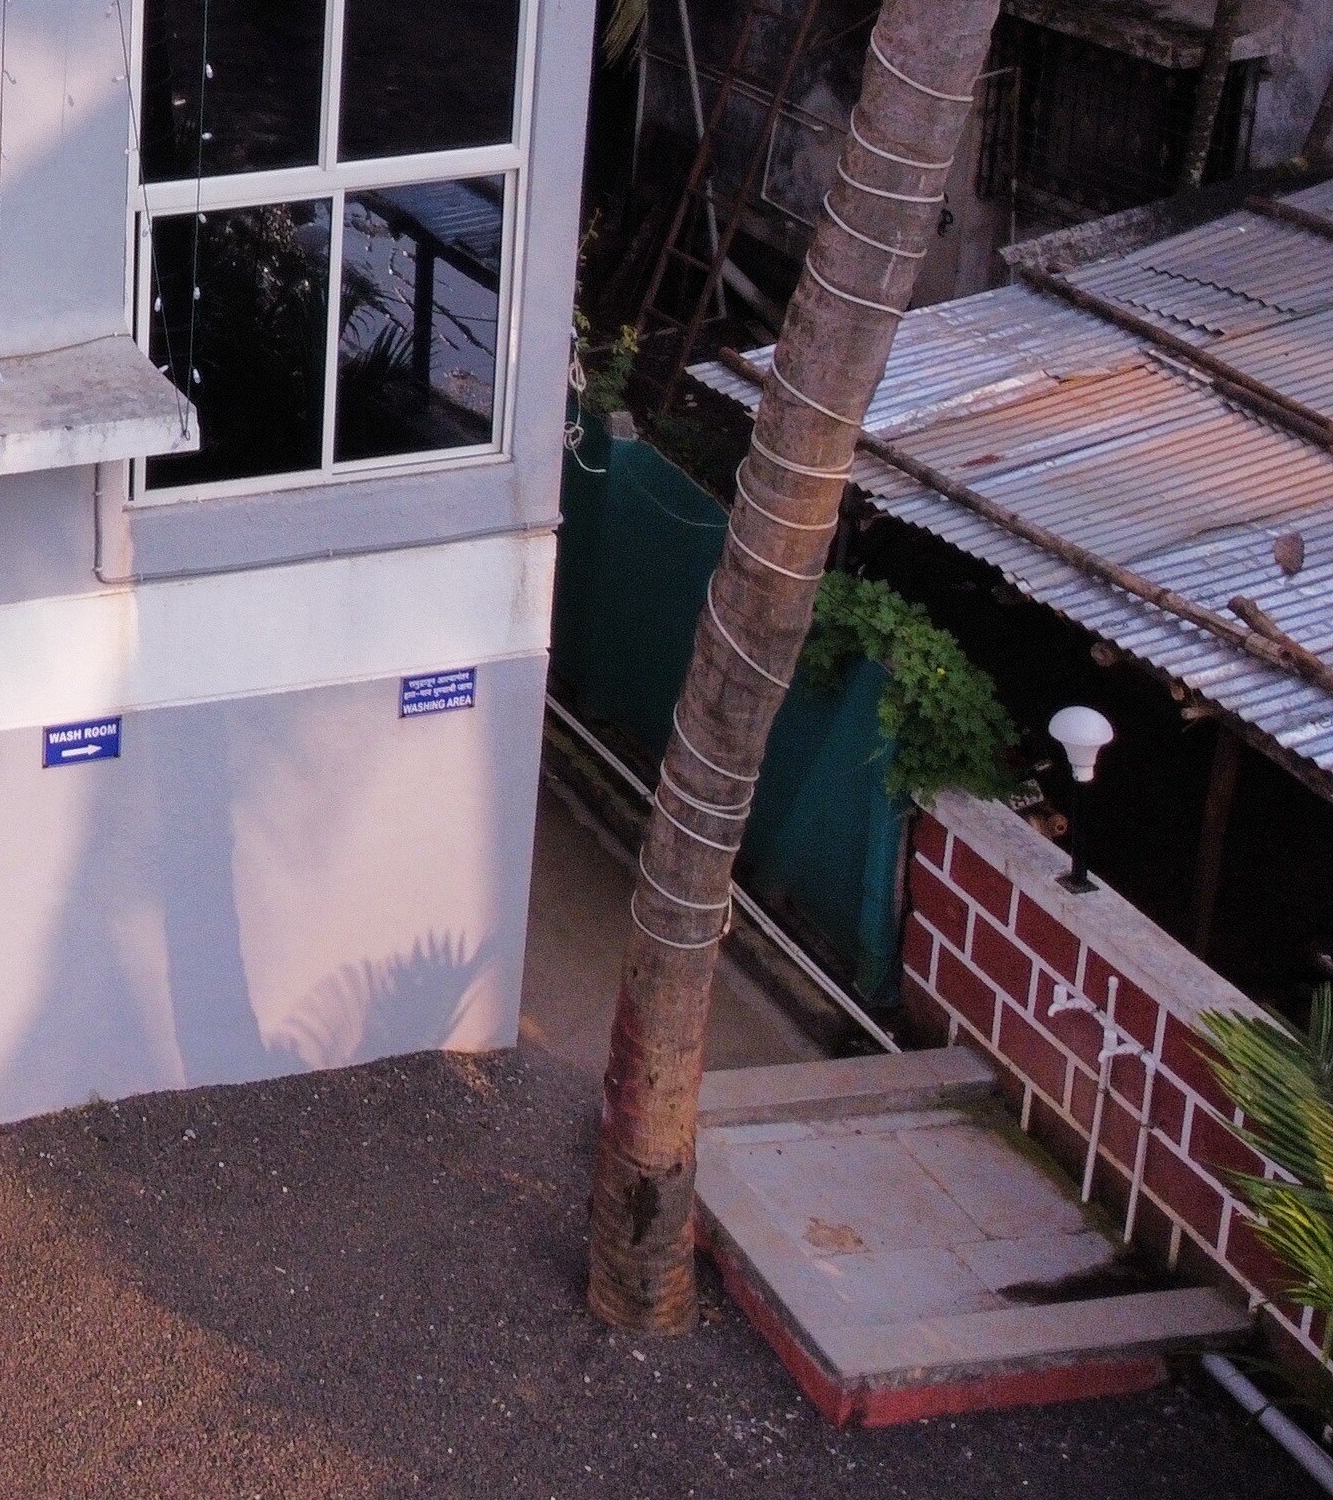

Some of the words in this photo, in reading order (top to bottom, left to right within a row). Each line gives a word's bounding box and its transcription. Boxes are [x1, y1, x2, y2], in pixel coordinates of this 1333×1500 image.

[403, 699, 445, 714] WASHING
[446, 694, 472, 708] AREA
[49, 729, 82, 744] WASH
[84, 724, 117, 739] ROOM
